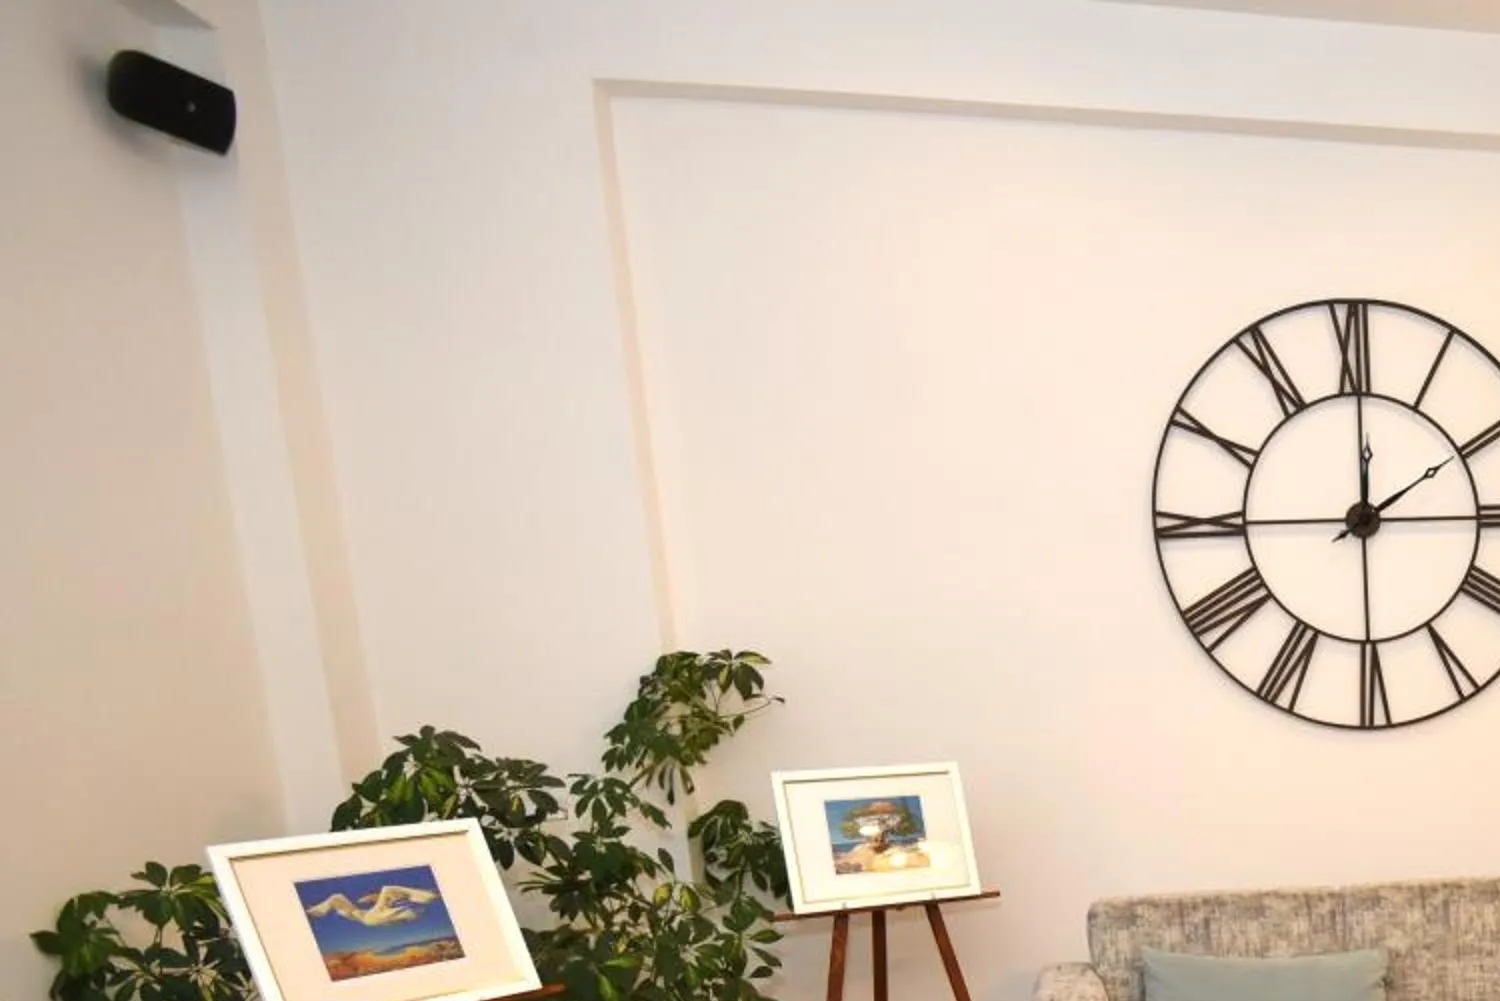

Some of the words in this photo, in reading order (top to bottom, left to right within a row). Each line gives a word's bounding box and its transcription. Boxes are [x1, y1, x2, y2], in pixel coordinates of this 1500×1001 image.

[1233, 325, 1307, 418] XI
[1328, 301, 1372, 394] XII
[1413, 328, 1456, 411] I
[1169, 403, 1260, 470] X
[1155, 510, 1246, 539] IX
[1182, 567, 1274, 654] VIII
[1256, 619, 1320, 713] VII
[1360, 641, 1393, 728] VI
[1424, 622, 1481, 701] V
